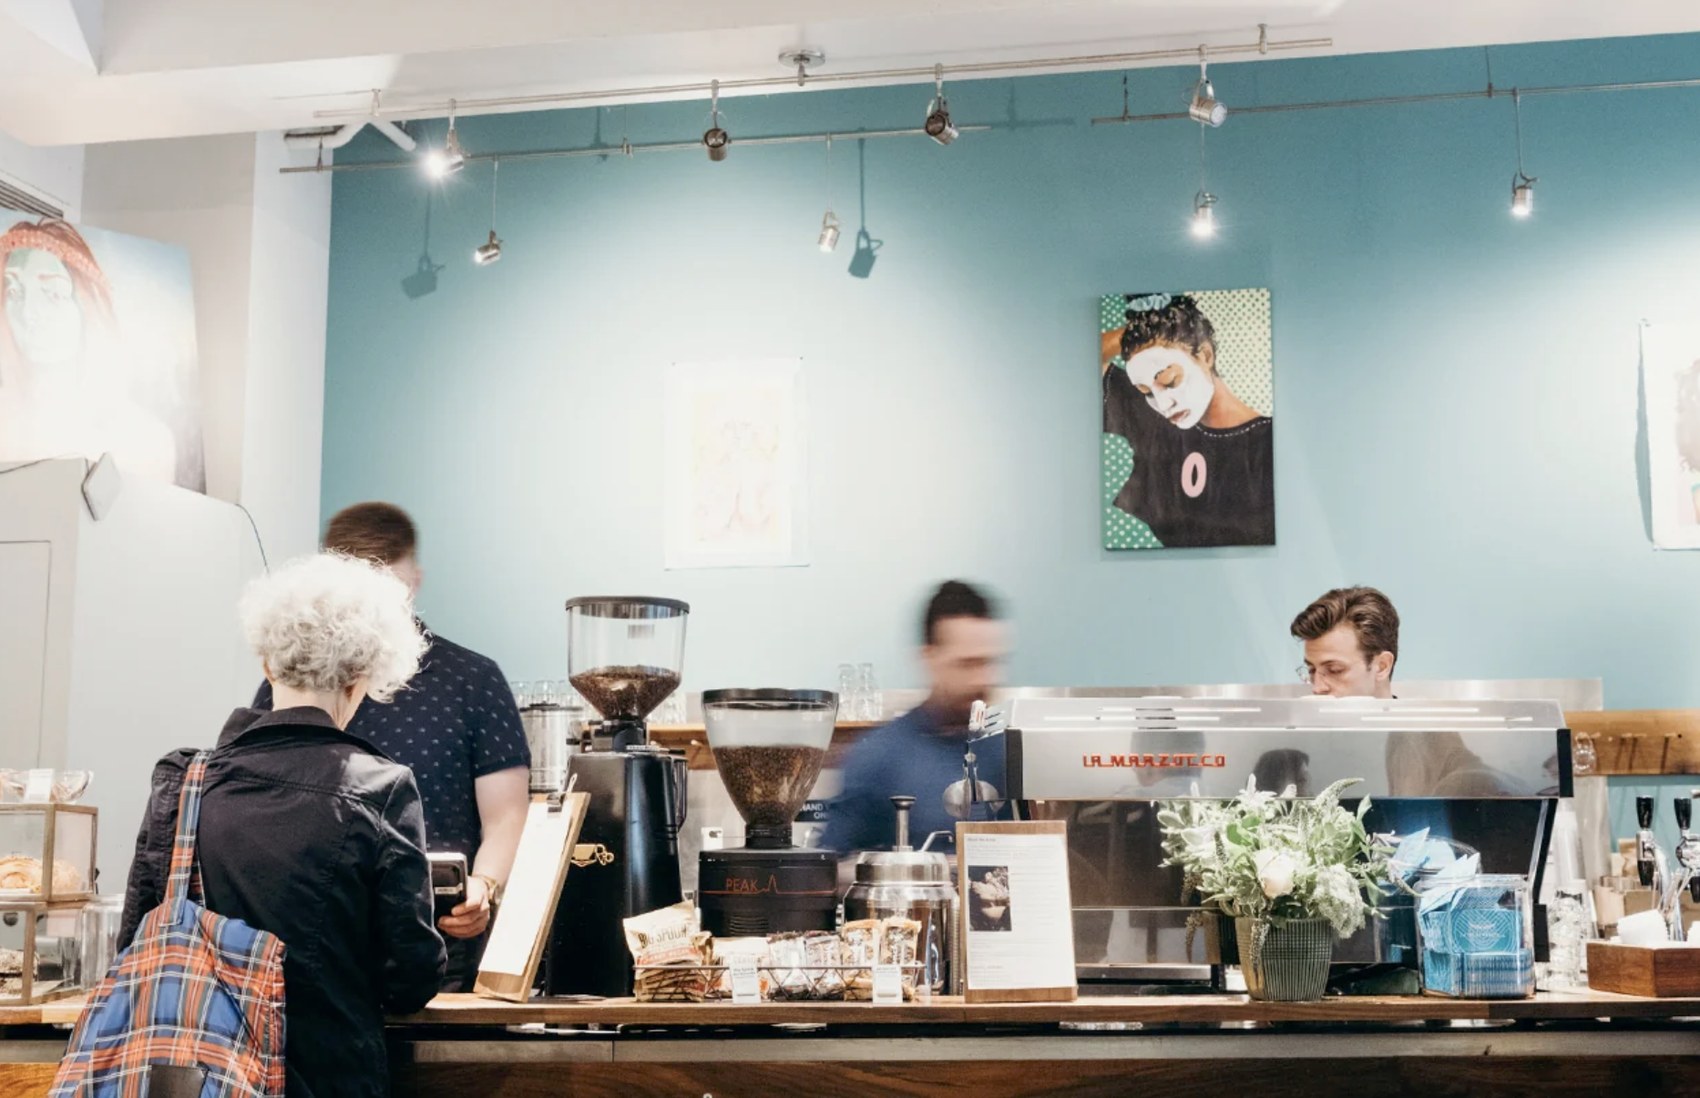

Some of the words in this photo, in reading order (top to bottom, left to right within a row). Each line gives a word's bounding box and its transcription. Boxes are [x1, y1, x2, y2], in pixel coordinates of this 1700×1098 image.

[1083, 753, 1101, 767] LA
[1111, 753, 1225, 767] MARZOCCO
[726, 878, 758, 892] PEAK
